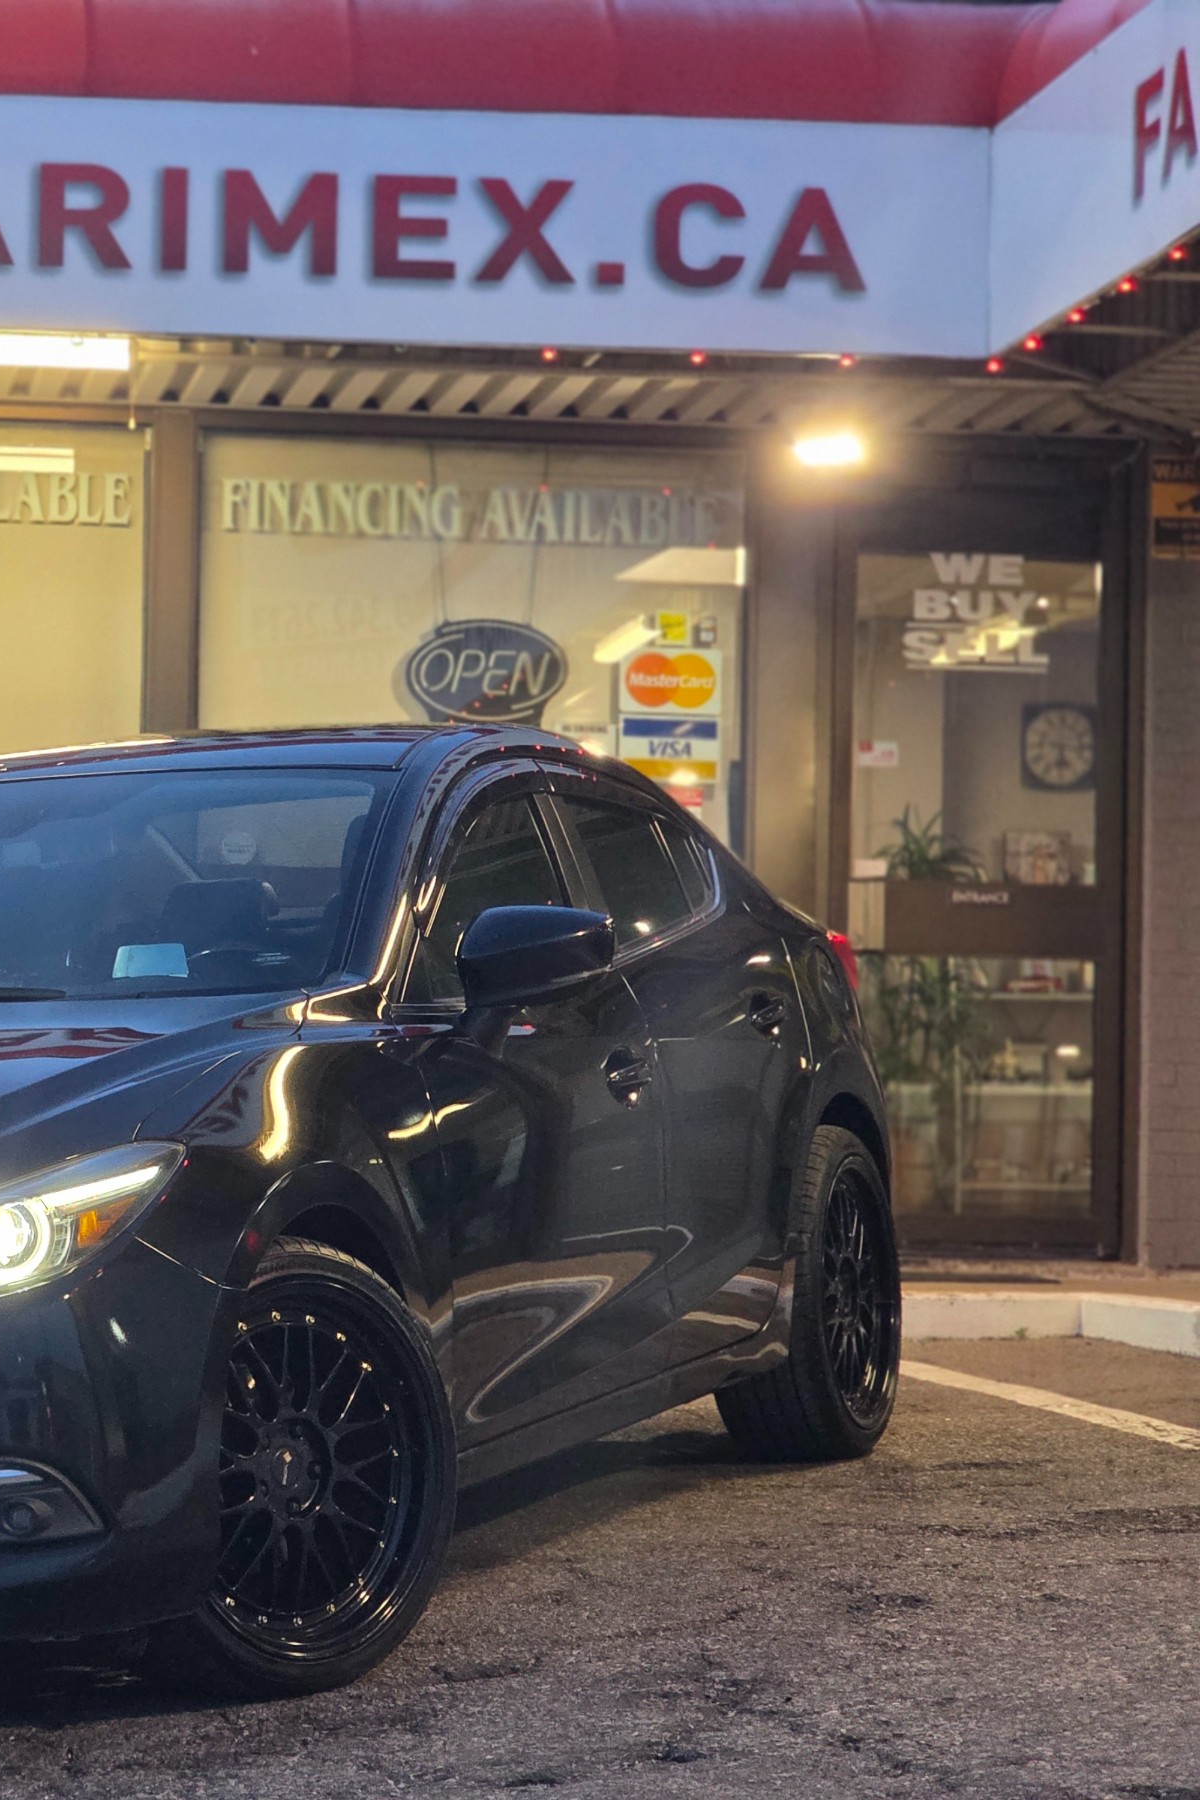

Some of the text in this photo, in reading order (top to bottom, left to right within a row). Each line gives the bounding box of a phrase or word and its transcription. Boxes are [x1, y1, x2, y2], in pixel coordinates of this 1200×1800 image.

[1131, 46, 1198, 204] FA
[221, 477, 721, 547] FINANCING AVAILABLE
[929, 552, 1025, 586] WE
[913, 589, 1037, 622] BUY
[902, 629, 1049, 664] SELL
[419, 649, 550, 696] OPEN
[629, 672, 714, 689] MasterCard
[648, 740, 693, 758] VISA
